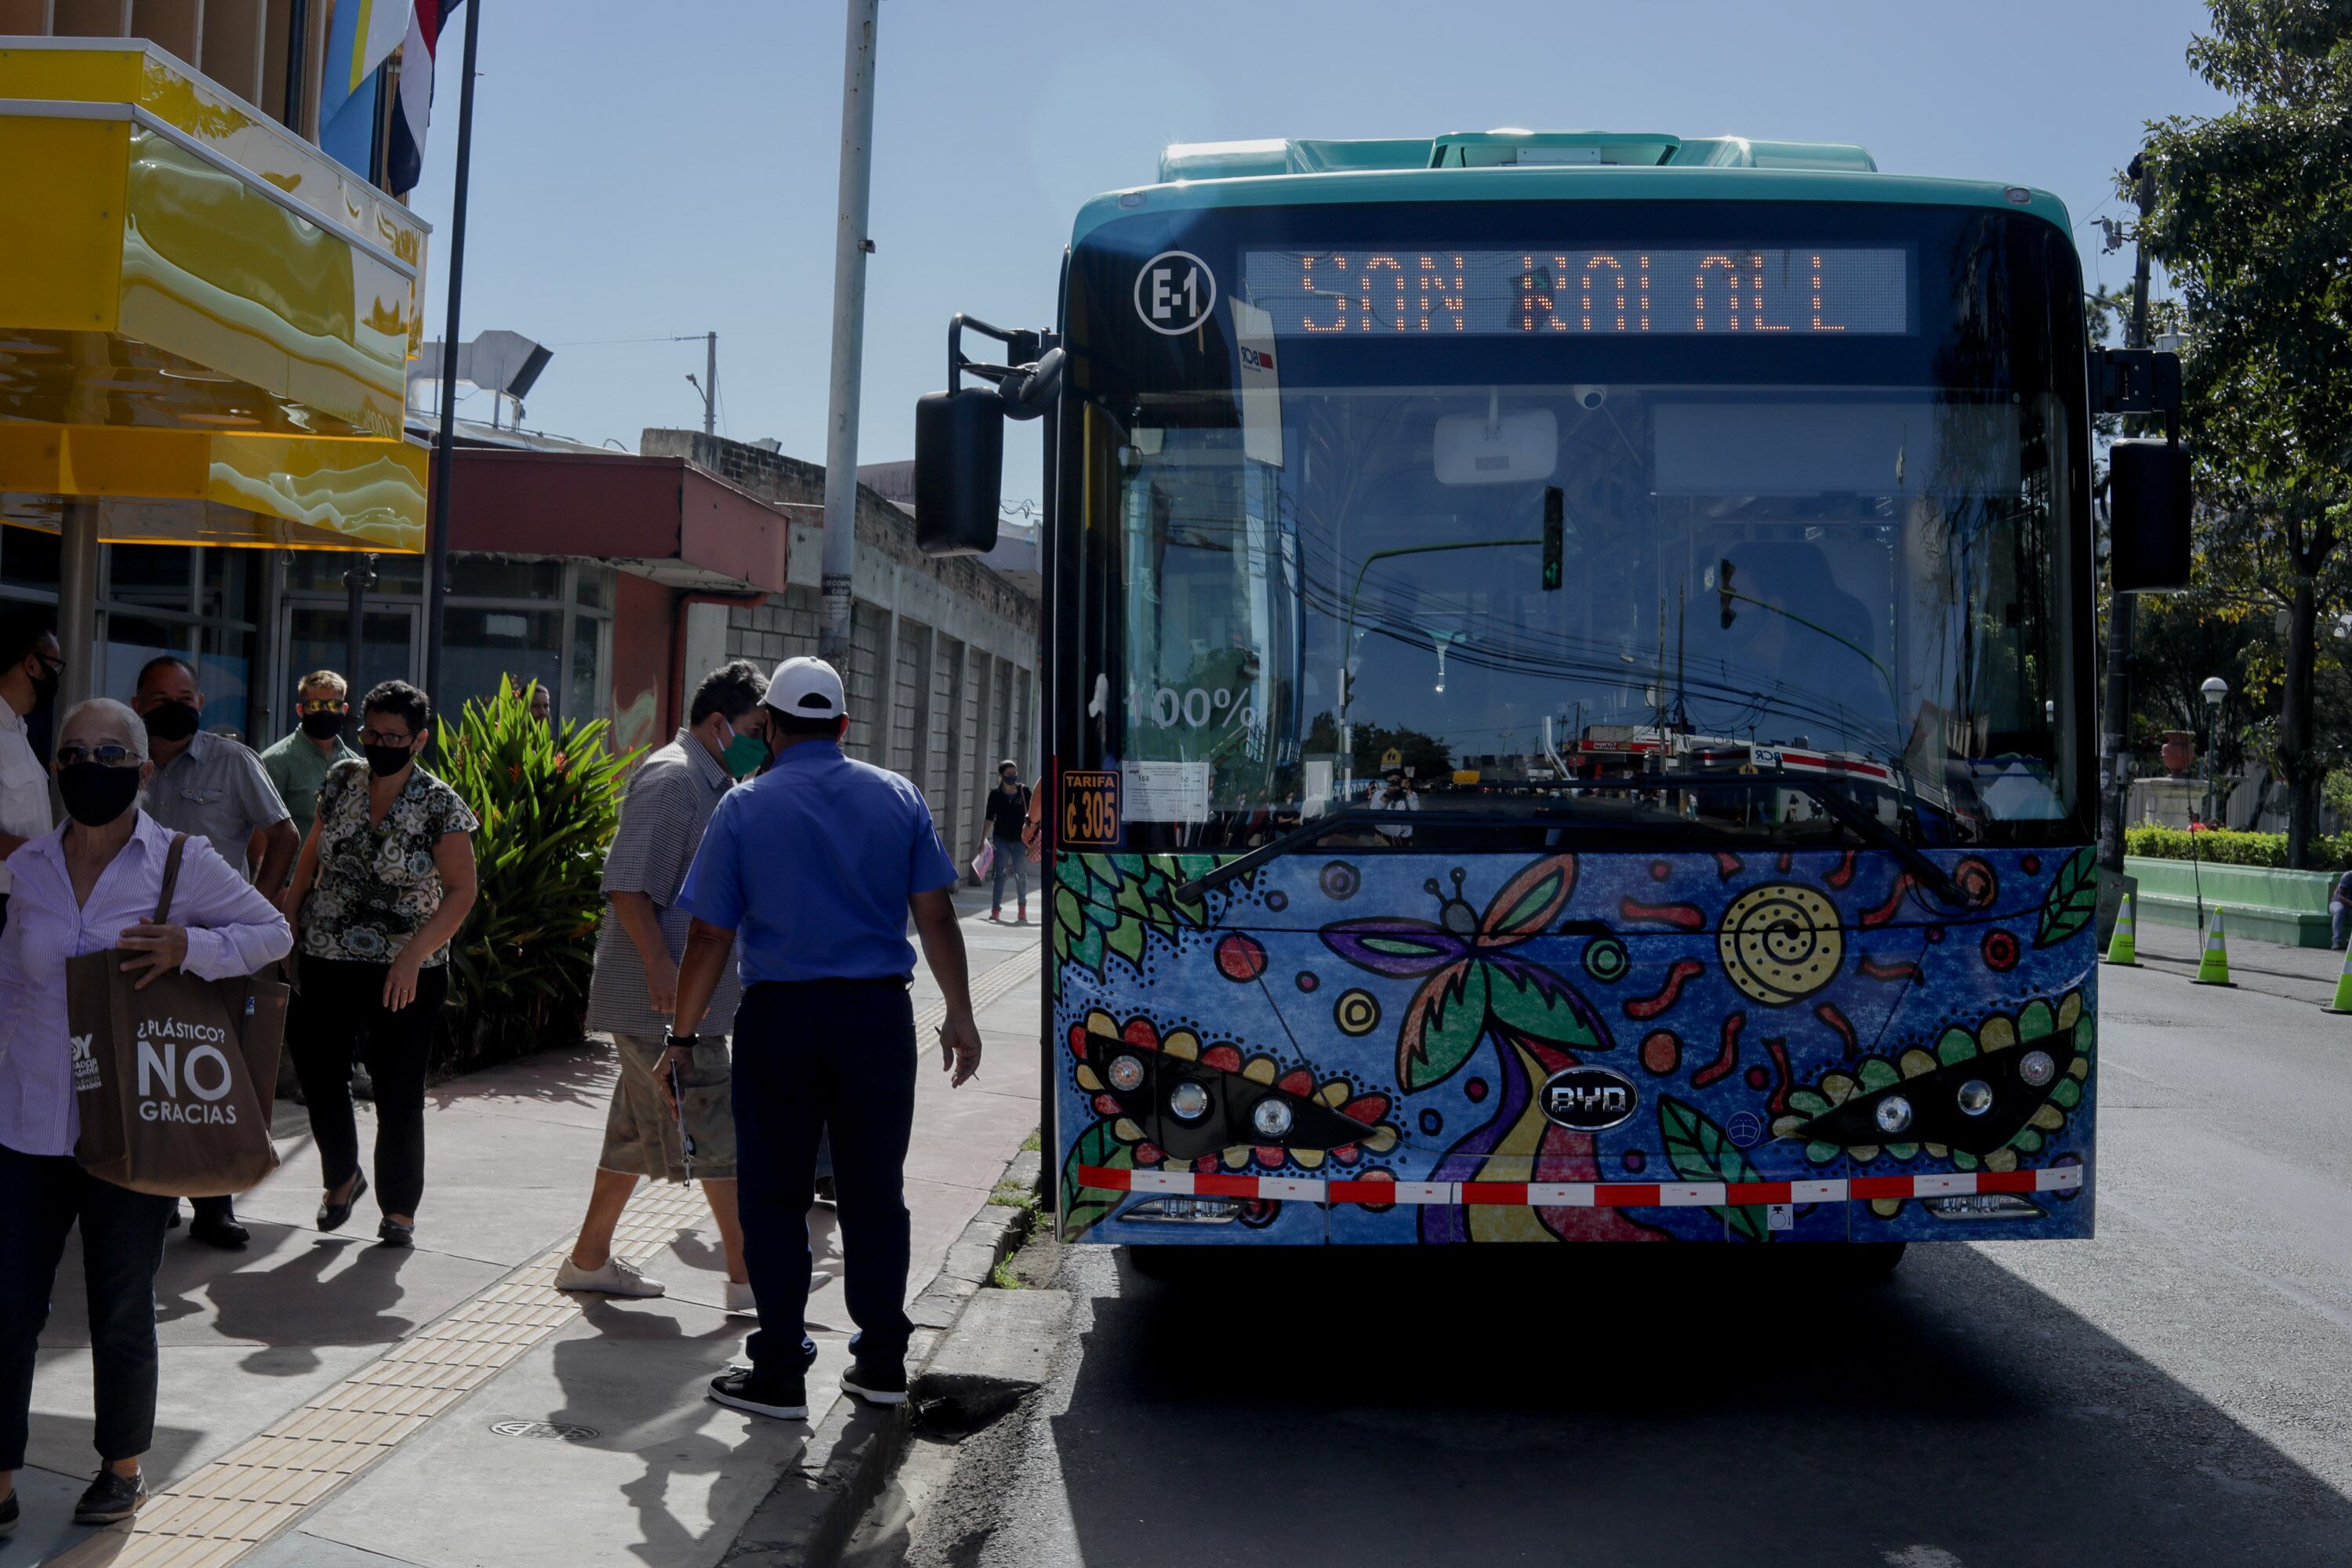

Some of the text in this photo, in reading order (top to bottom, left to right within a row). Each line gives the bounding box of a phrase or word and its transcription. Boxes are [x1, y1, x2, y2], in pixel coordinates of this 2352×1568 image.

[1152, 267, 1197, 319] E-1
[1123, 688, 1256, 728] 100%
[1066, 775, 1116, 787] TARIFA
[1082, 790, 1116, 838] 305
[136, 1017, 225, 1043] ¿PLÁSTICO?
[136, 1040, 232, 1102] NO
[139, 1101, 237, 1124] GRACIAS
[1551, 1087, 1627, 1113] BYD
